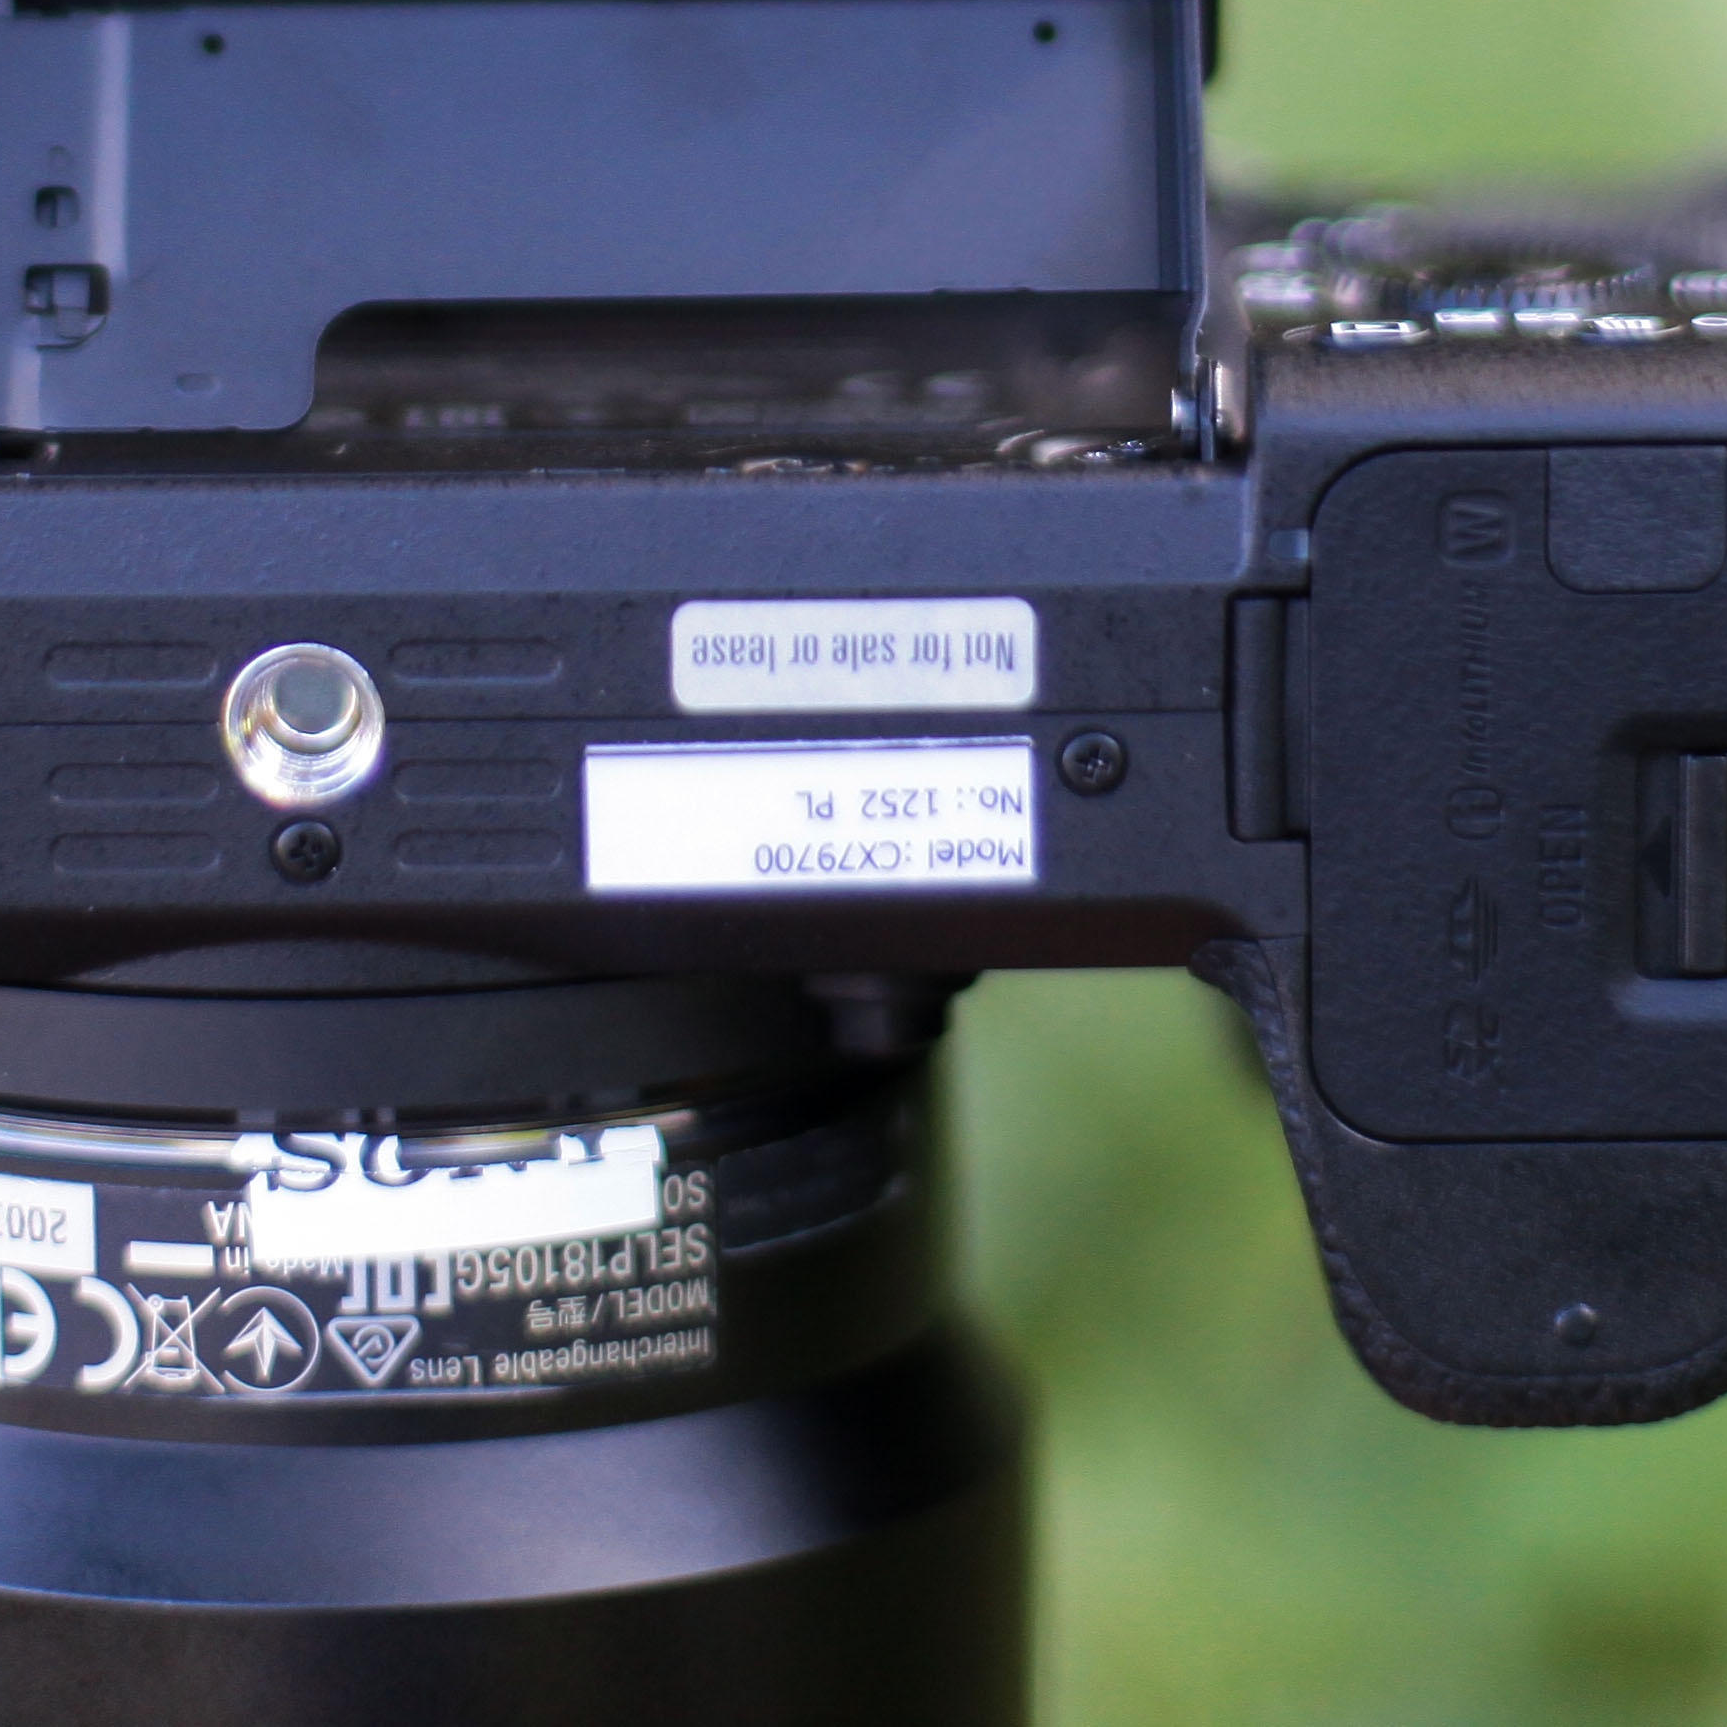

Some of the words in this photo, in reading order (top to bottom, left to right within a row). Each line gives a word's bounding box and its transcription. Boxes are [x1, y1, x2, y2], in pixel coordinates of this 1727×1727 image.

[690, 634, 776, 674] lease
[789, 634, 819, 667] or
[831, 633, 896, 673] sale
[910, 633, 953, 672] for
[963, 632, 1016, 672] Not
[795, 790, 835, 820] PL
[860, 788, 939, 818] 1252
[927, 837, 1025, 871] Model
[1536, 802, 1587, 929] OPEN
[454, 1221, 710, 1297] SELP18105G
[409, 1353, 480, 1385] Lens
[493, 1327, 710, 1380] Interchangeable
